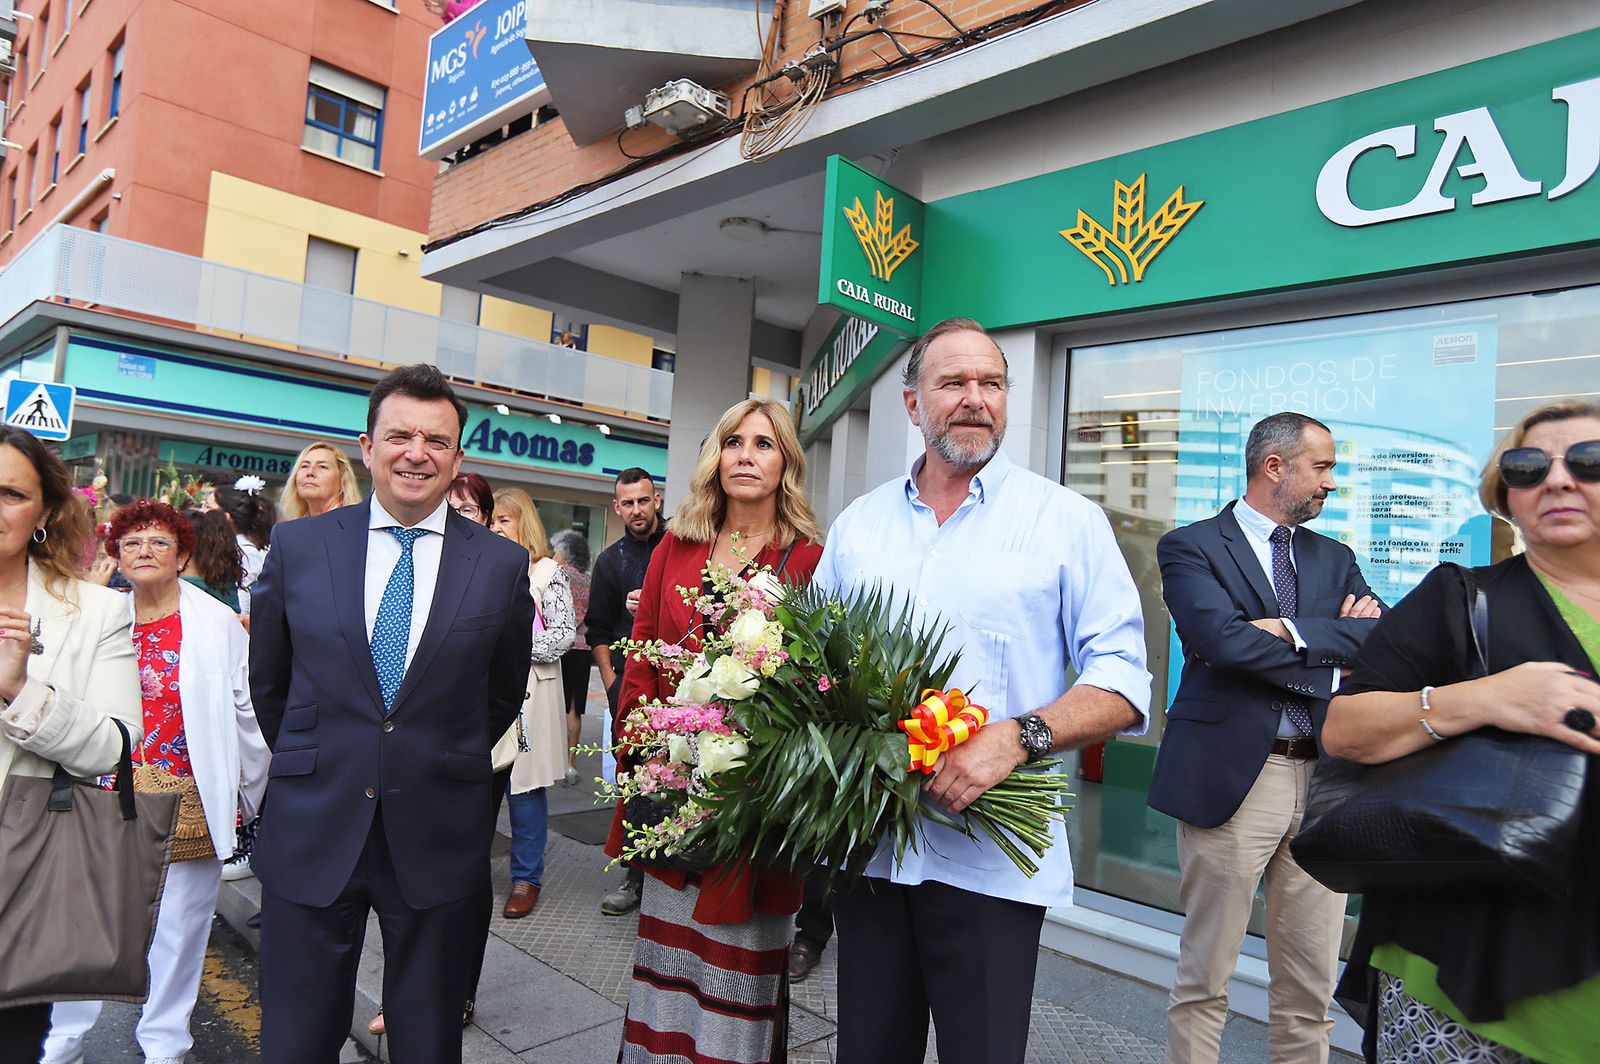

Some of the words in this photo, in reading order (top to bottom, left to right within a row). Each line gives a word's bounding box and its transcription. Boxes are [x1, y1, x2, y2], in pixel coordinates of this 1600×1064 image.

[431, 42, 467, 83] MGS
[837, 278, 871, 304] CAJA
[873, 292, 915, 322] RURAL
[1437, 336, 1472, 345] AENOR
[807, 352, 829, 415] CAJA
[831, 317, 878, 388] RURAL
[1197, 360, 1337, 392] FONDOS
[1351, 354, 1397, 381] DE
[1197, 383, 1376, 420] INVERSIÓN
[195, 447, 292, 474] Aromas
[463, 418, 595, 466] Aromas
[1389, 451, 1429, 459] inversión
